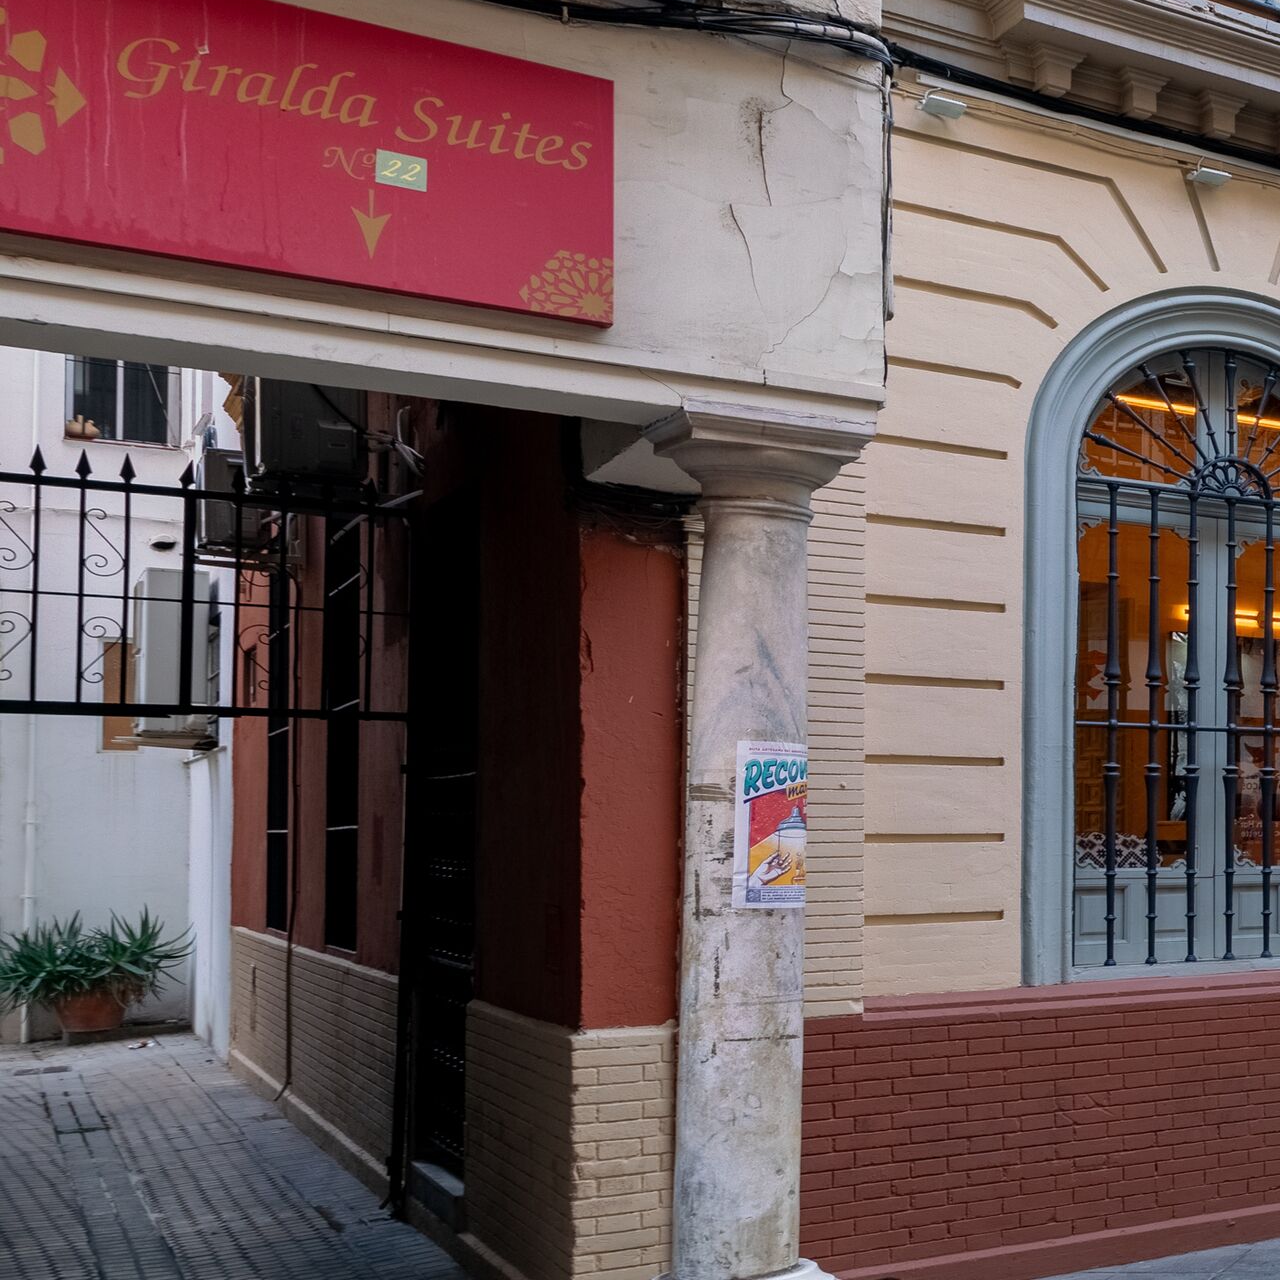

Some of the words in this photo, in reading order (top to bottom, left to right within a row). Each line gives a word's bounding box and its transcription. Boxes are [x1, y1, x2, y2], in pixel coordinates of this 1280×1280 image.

[116, 37, 379, 127] Giralda
[395, 95, 593, 171] Suites
[381, 159, 422, 182] 22
